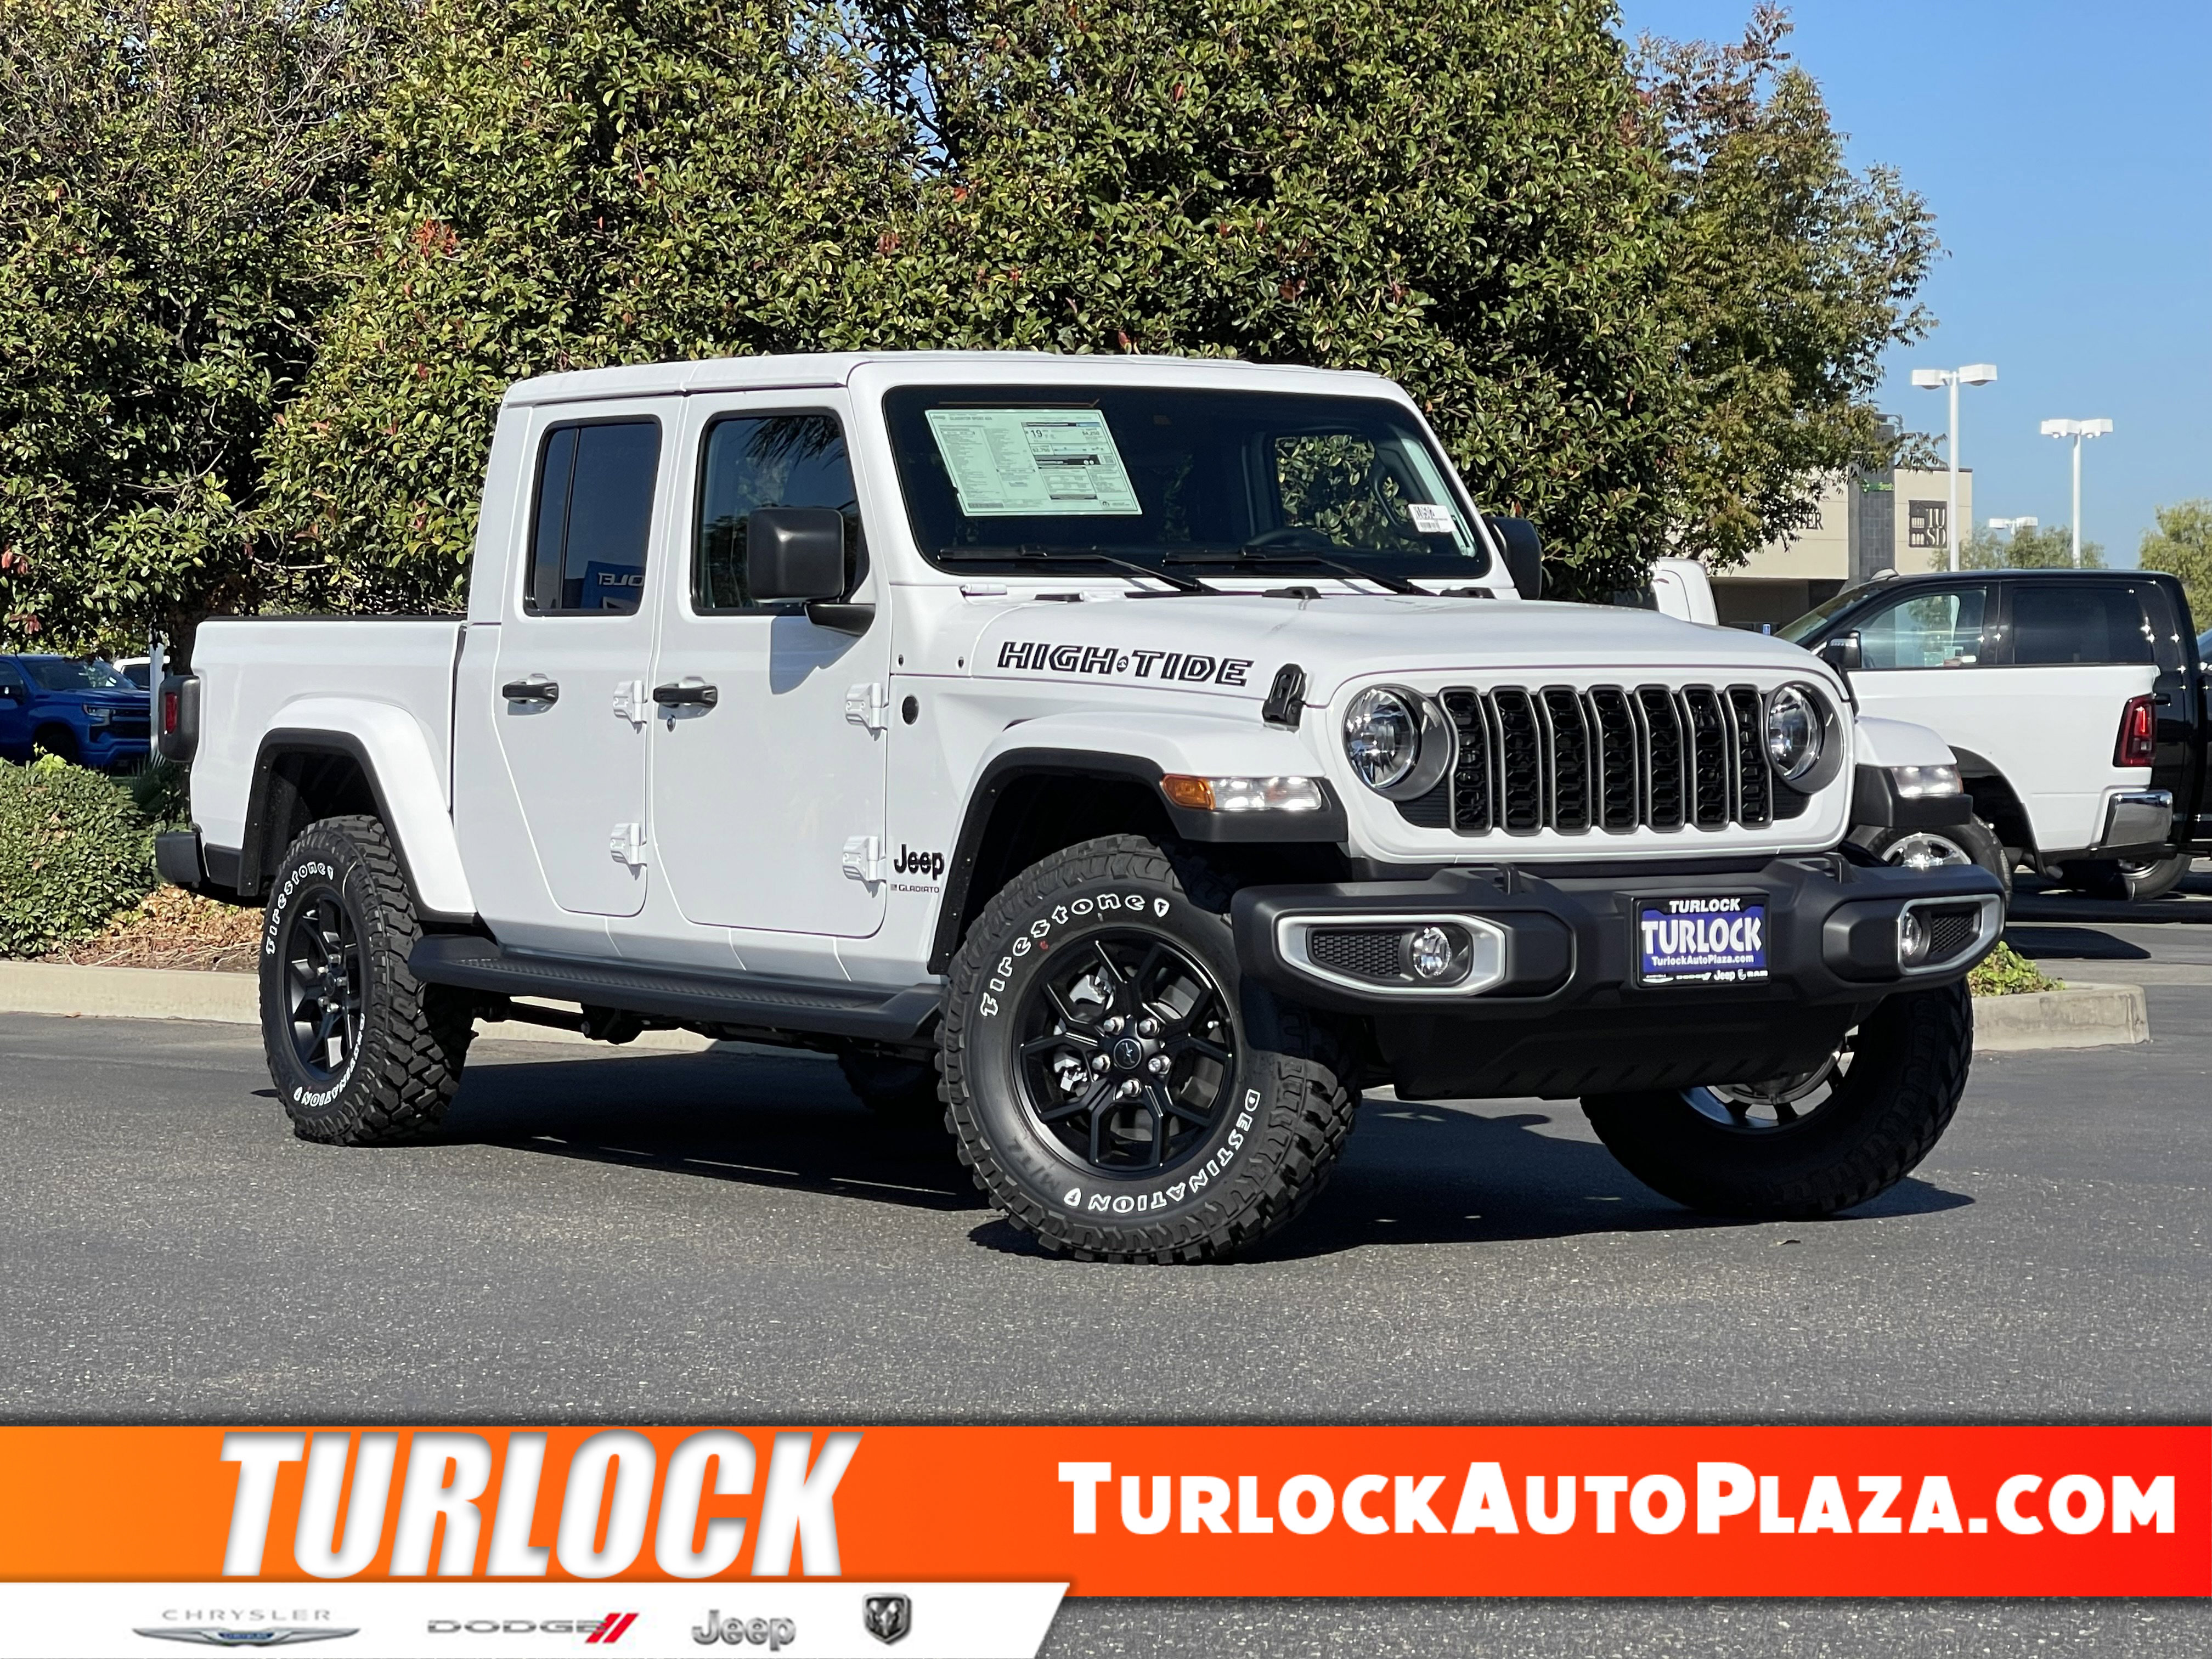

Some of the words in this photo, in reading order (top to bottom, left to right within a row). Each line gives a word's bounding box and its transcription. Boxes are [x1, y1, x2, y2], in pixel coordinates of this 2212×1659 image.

[1031, 430, 1043, 438] 19
[997, 641, 1120, 675] HIGH
[1131, 650, 1254, 687] TIDE
[894, 844, 945, 881] Jeep
[1669, 898, 1741, 913] TURLOCK
[1641, 917, 1762, 955] TURLOCK
[1651, 954, 1754, 966] TurlockAutoPlaza.com
[1714, 969, 1736, 981] Jeep
[1088, 1088, 1261, 1214] DESTINATION
